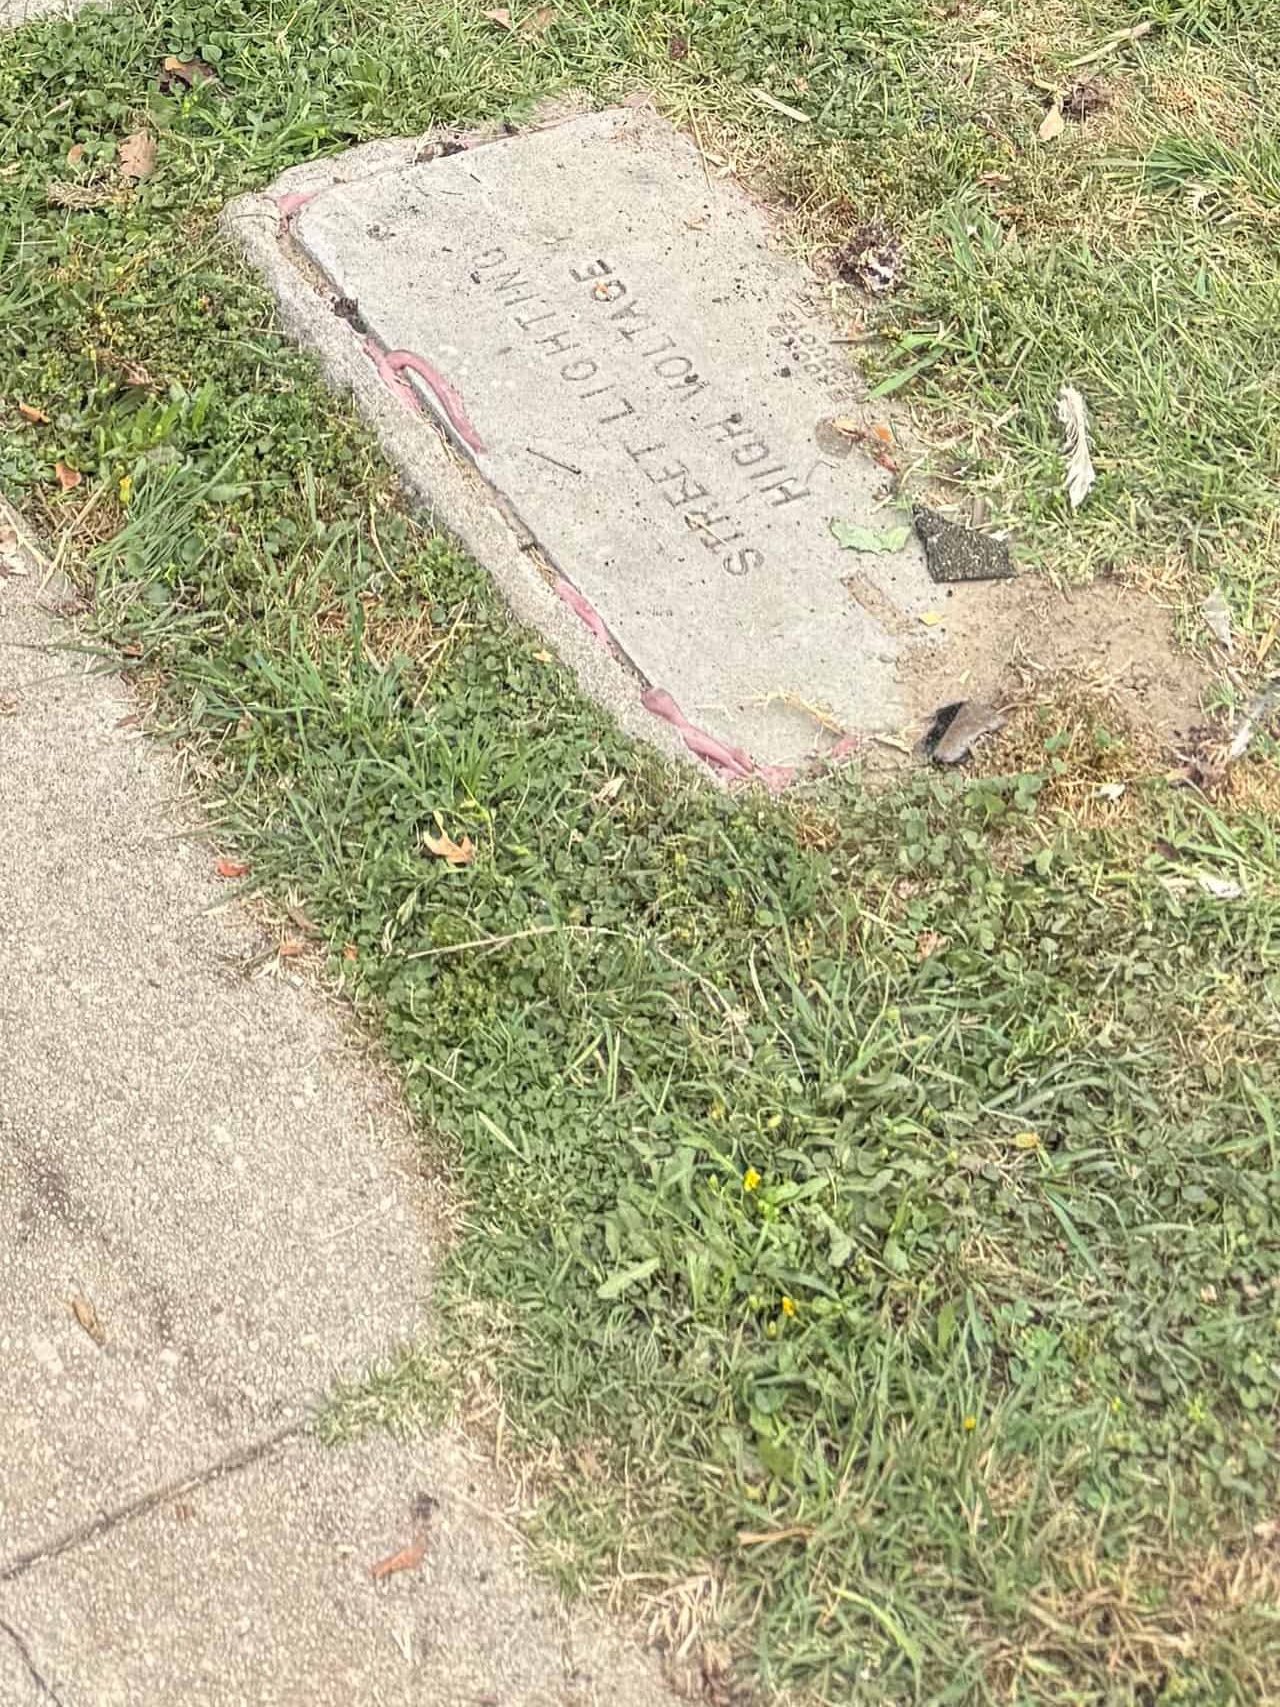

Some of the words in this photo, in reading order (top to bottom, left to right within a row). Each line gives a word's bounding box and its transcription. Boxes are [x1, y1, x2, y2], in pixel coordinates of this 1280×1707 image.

[472, 245, 634, 427] LIGHTING
[569, 257, 710, 403] VOLTAGE
[626, 445, 764, 577] STREET
[710, 411, 812, 511] HIGH
